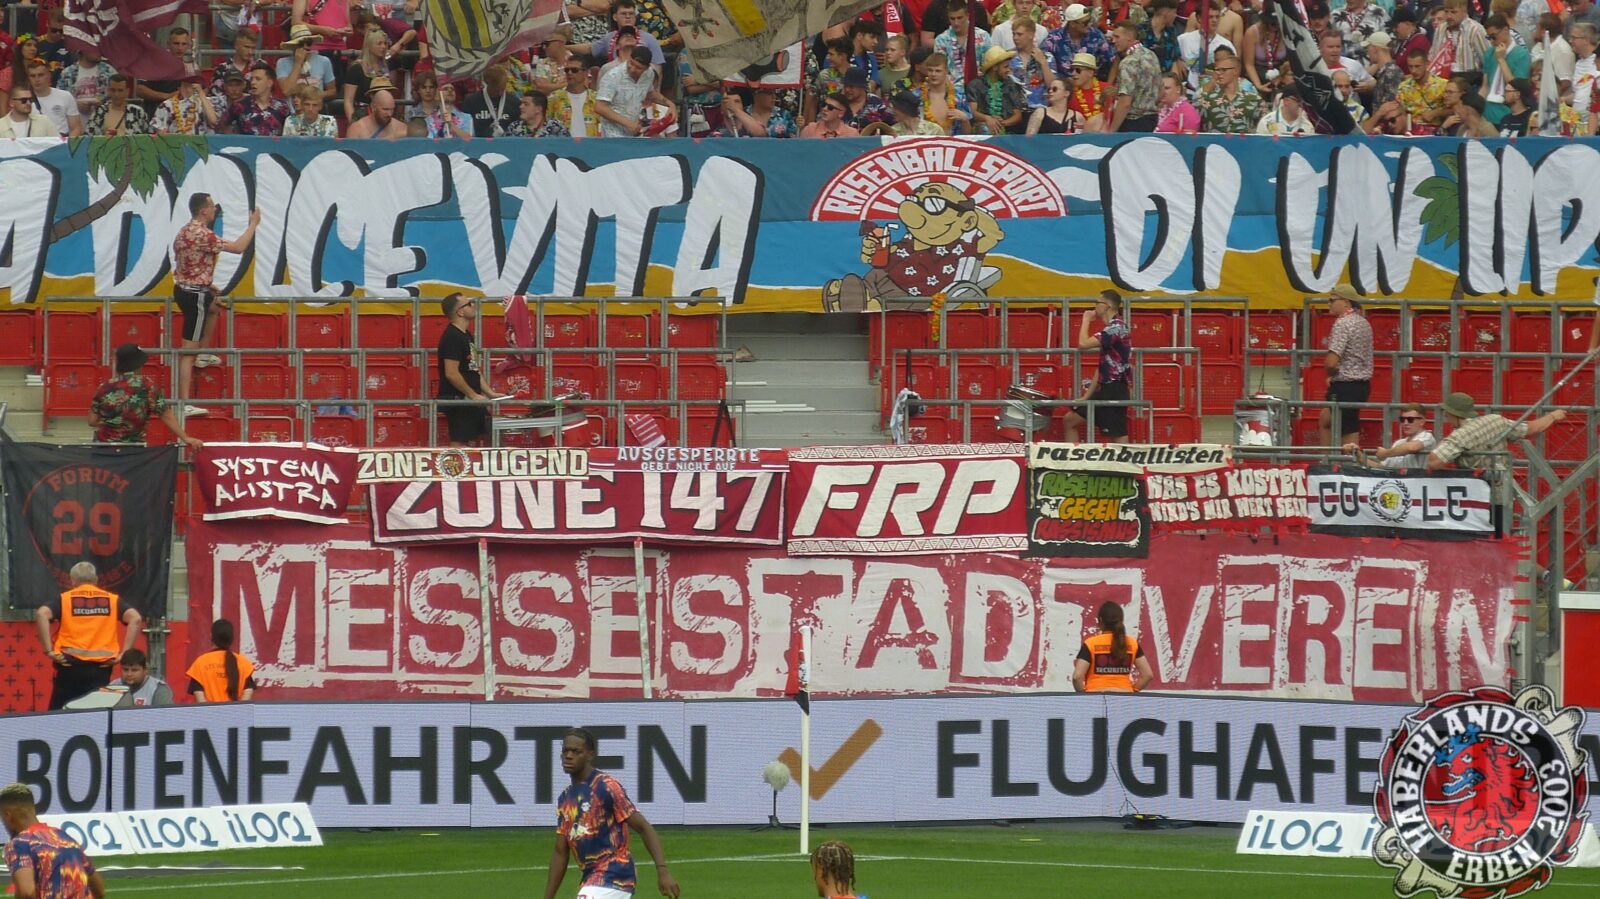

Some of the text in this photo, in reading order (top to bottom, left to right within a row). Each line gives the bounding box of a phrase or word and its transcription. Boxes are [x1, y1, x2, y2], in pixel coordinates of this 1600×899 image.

[823, 147, 1058, 215] RASENBALLSPORT
[451, 152, 766, 308] VITA
[1099, 136, 1241, 294] DI
[1276, 139, 1436, 297] UN
[211, 456, 340, 485] SYSTEMA
[357, 449, 589, 479] ZONE JUGEND
[617, 448, 760, 463] AUSGESPERRTE
[640, 461, 736, 472] GEBT NICHT AUF
[1036, 446, 1225, 465] rasenballisten
[48, 467, 130, 495] FORUM
[215, 480, 337, 510] ALISTRA
[1040, 472, 1136, 498] RASENBALL
[1193, 472, 1221, 498] ES
[1224, 468, 1308, 497] KOSTET
[386, 471, 774, 532] ZONE 147
[792, 459, 1020, 538] FRP
[1059, 497, 1120, 521] GEGEN
[1276, 497, 1308, 518] SEIN
[52, 500, 122, 557] 29
[1034, 518, 1139, 542] RASSISMUS
[73, 607, 109, 615] SECURITAS
[937, 717, 1396, 807] FLUGHAFE
[61, 809, 312, 851] OQ iLOQ iLOQ
[1247, 815, 1344, 853] iLOQ
